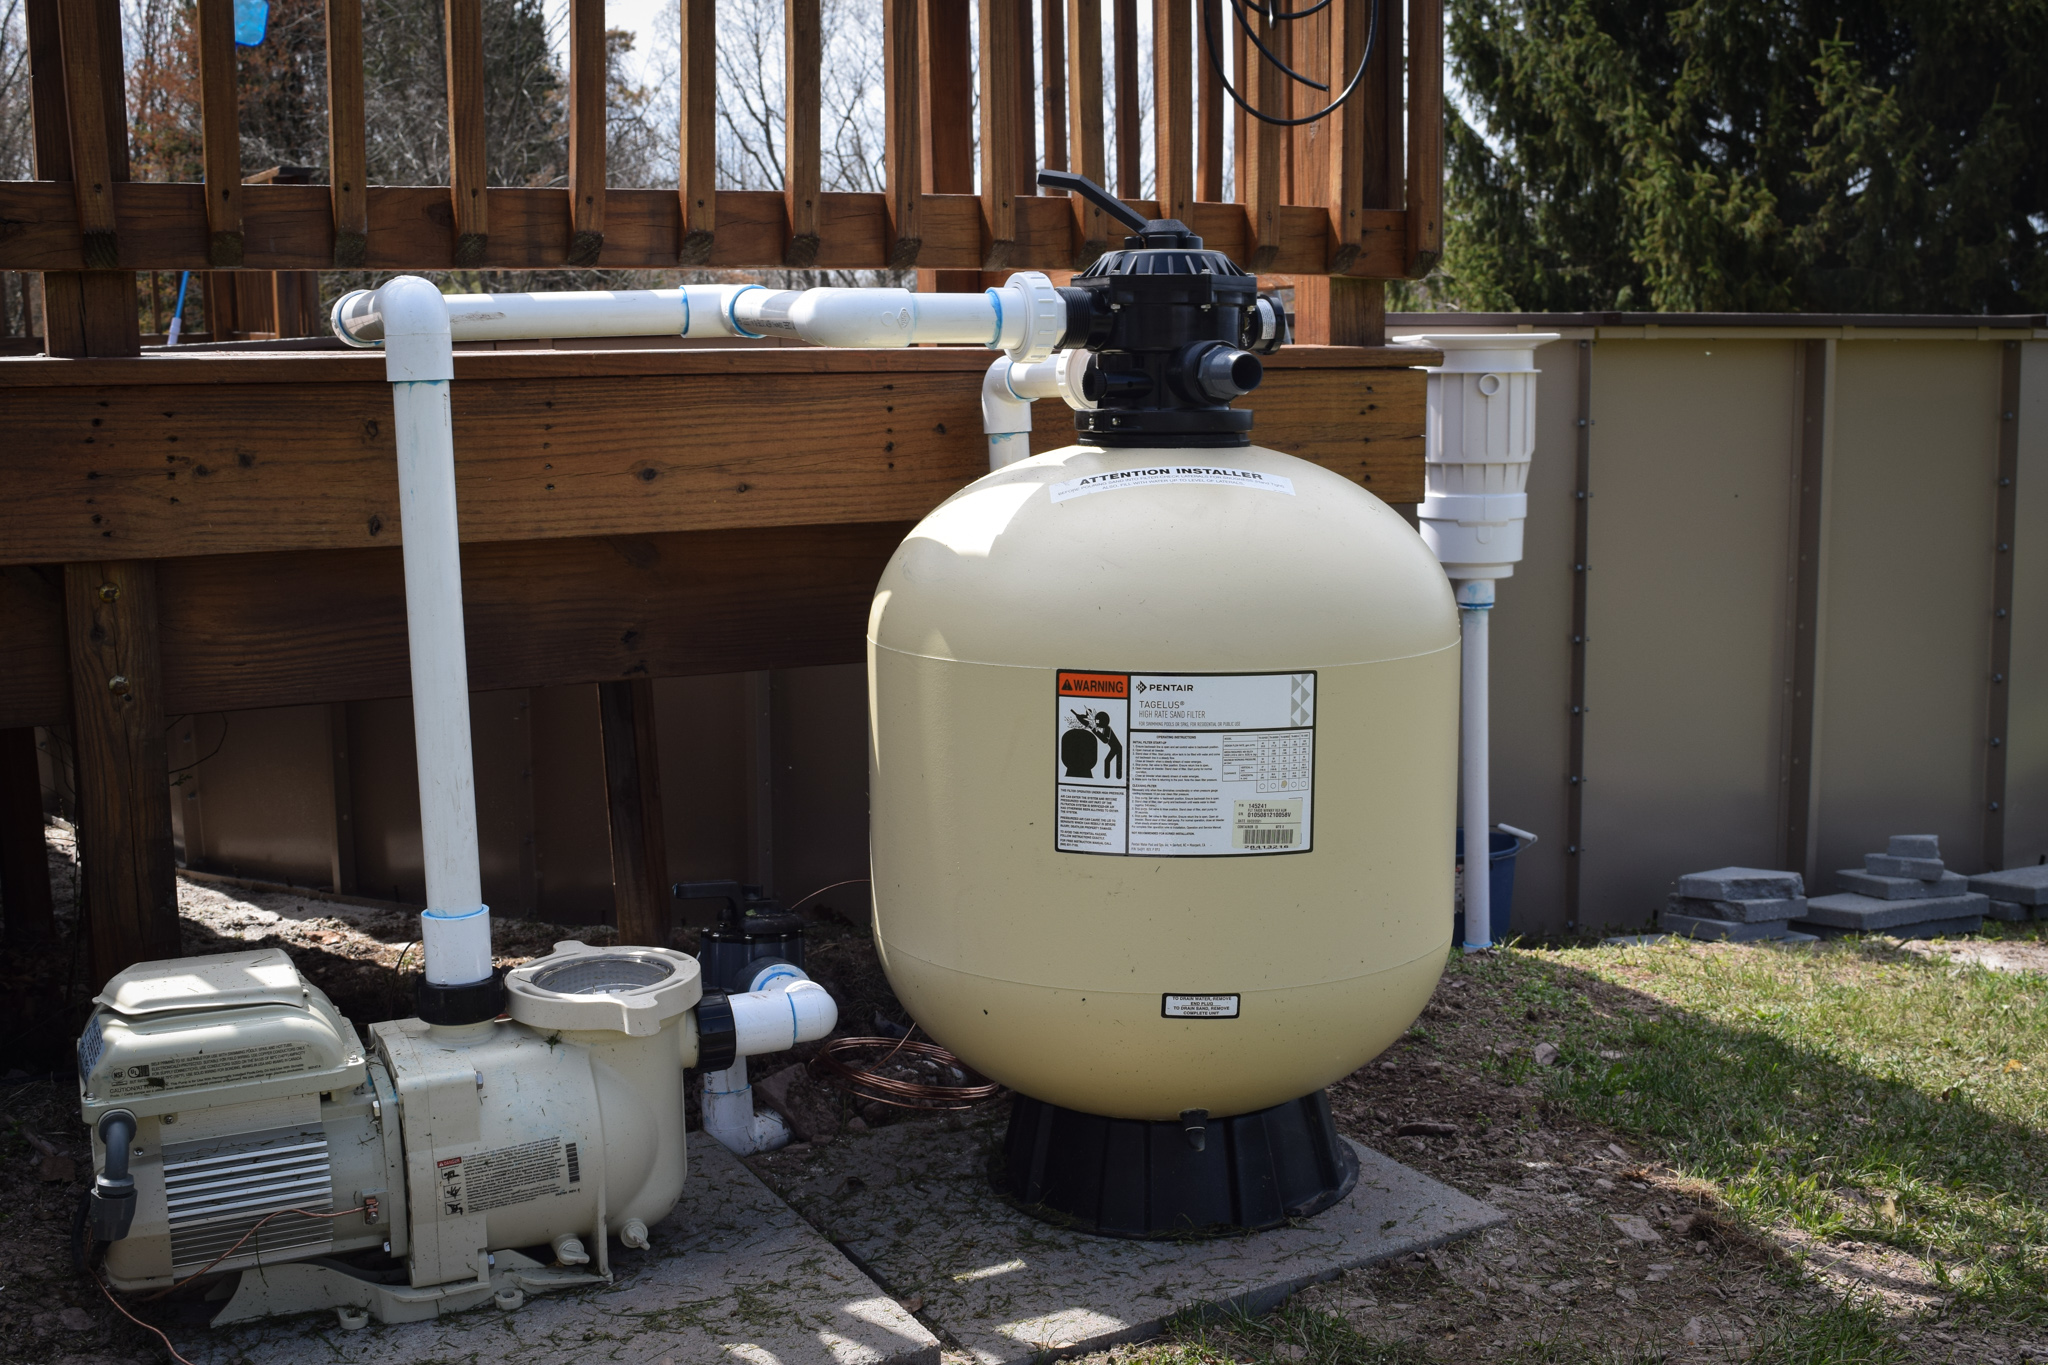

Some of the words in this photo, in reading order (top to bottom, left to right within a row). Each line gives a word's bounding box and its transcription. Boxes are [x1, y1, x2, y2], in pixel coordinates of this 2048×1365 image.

[1080, 468, 1171, 486] ATTENTION
[1176, 468, 1263, 480] INSTALLER
[1073, 679, 1124, 693] WARNING
[1149, 684, 1194, 692] PENTAIR
[1139, 710, 1153, 719] HIGH
[1154, 710, 1168, 719] RATE
[1169, 710, 1185, 719] SAND
[1186, 710, 1206, 719] FILTER
[113, 1071, 124, 1079] NSF
